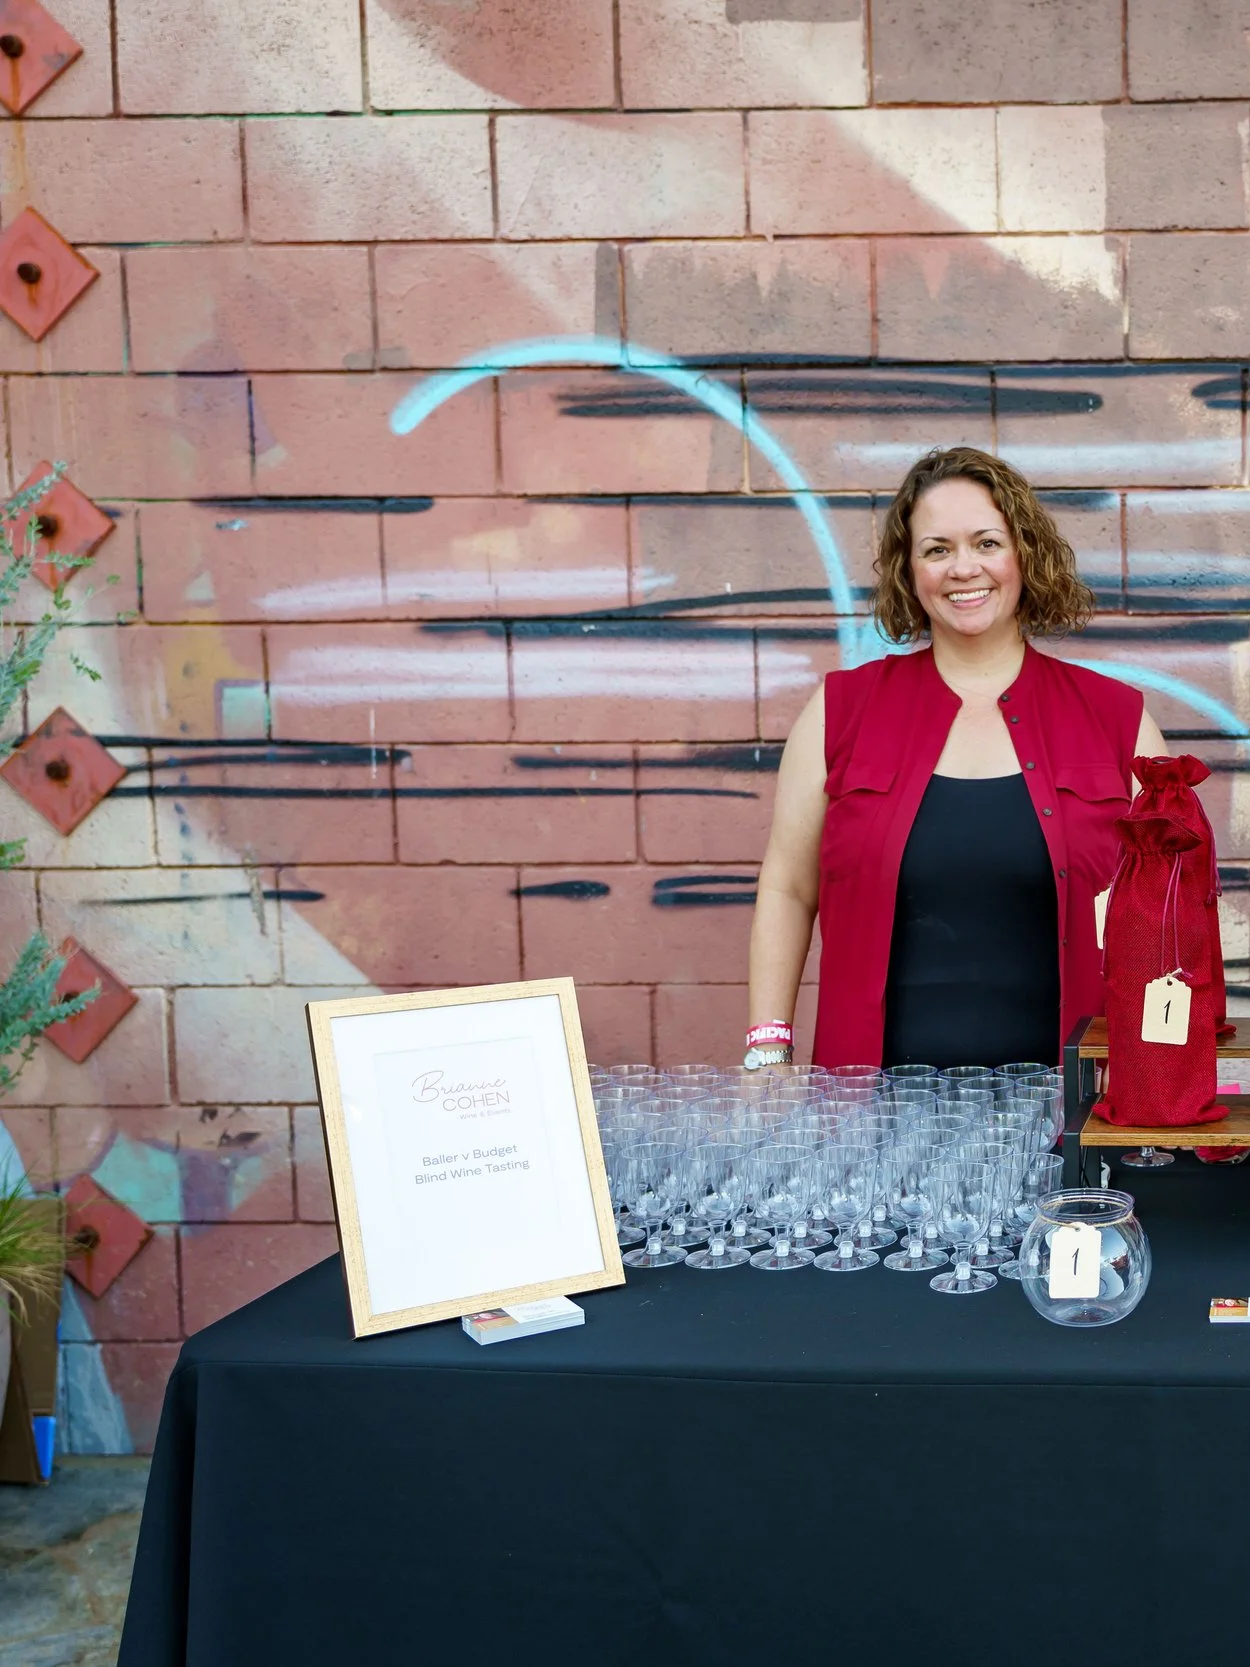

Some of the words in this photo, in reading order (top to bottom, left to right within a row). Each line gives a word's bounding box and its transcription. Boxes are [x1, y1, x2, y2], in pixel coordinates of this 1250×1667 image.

[1164, 999, 1171, 1024] 1
[412, 1070, 506, 1102] Brianne
[443, 1090, 510, 1111] COHEN
[422, 1154, 458, 1167] Baller
[462, 1153, 469, 1161] v
[472, 1144, 518, 1158] Budget
[415, 1171, 447, 1185] Blind
[450, 1167, 482, 1179] Wine
[484, 1160, 530, 1174] Tasting
[1072, 1248, 1079, 1276] 1
